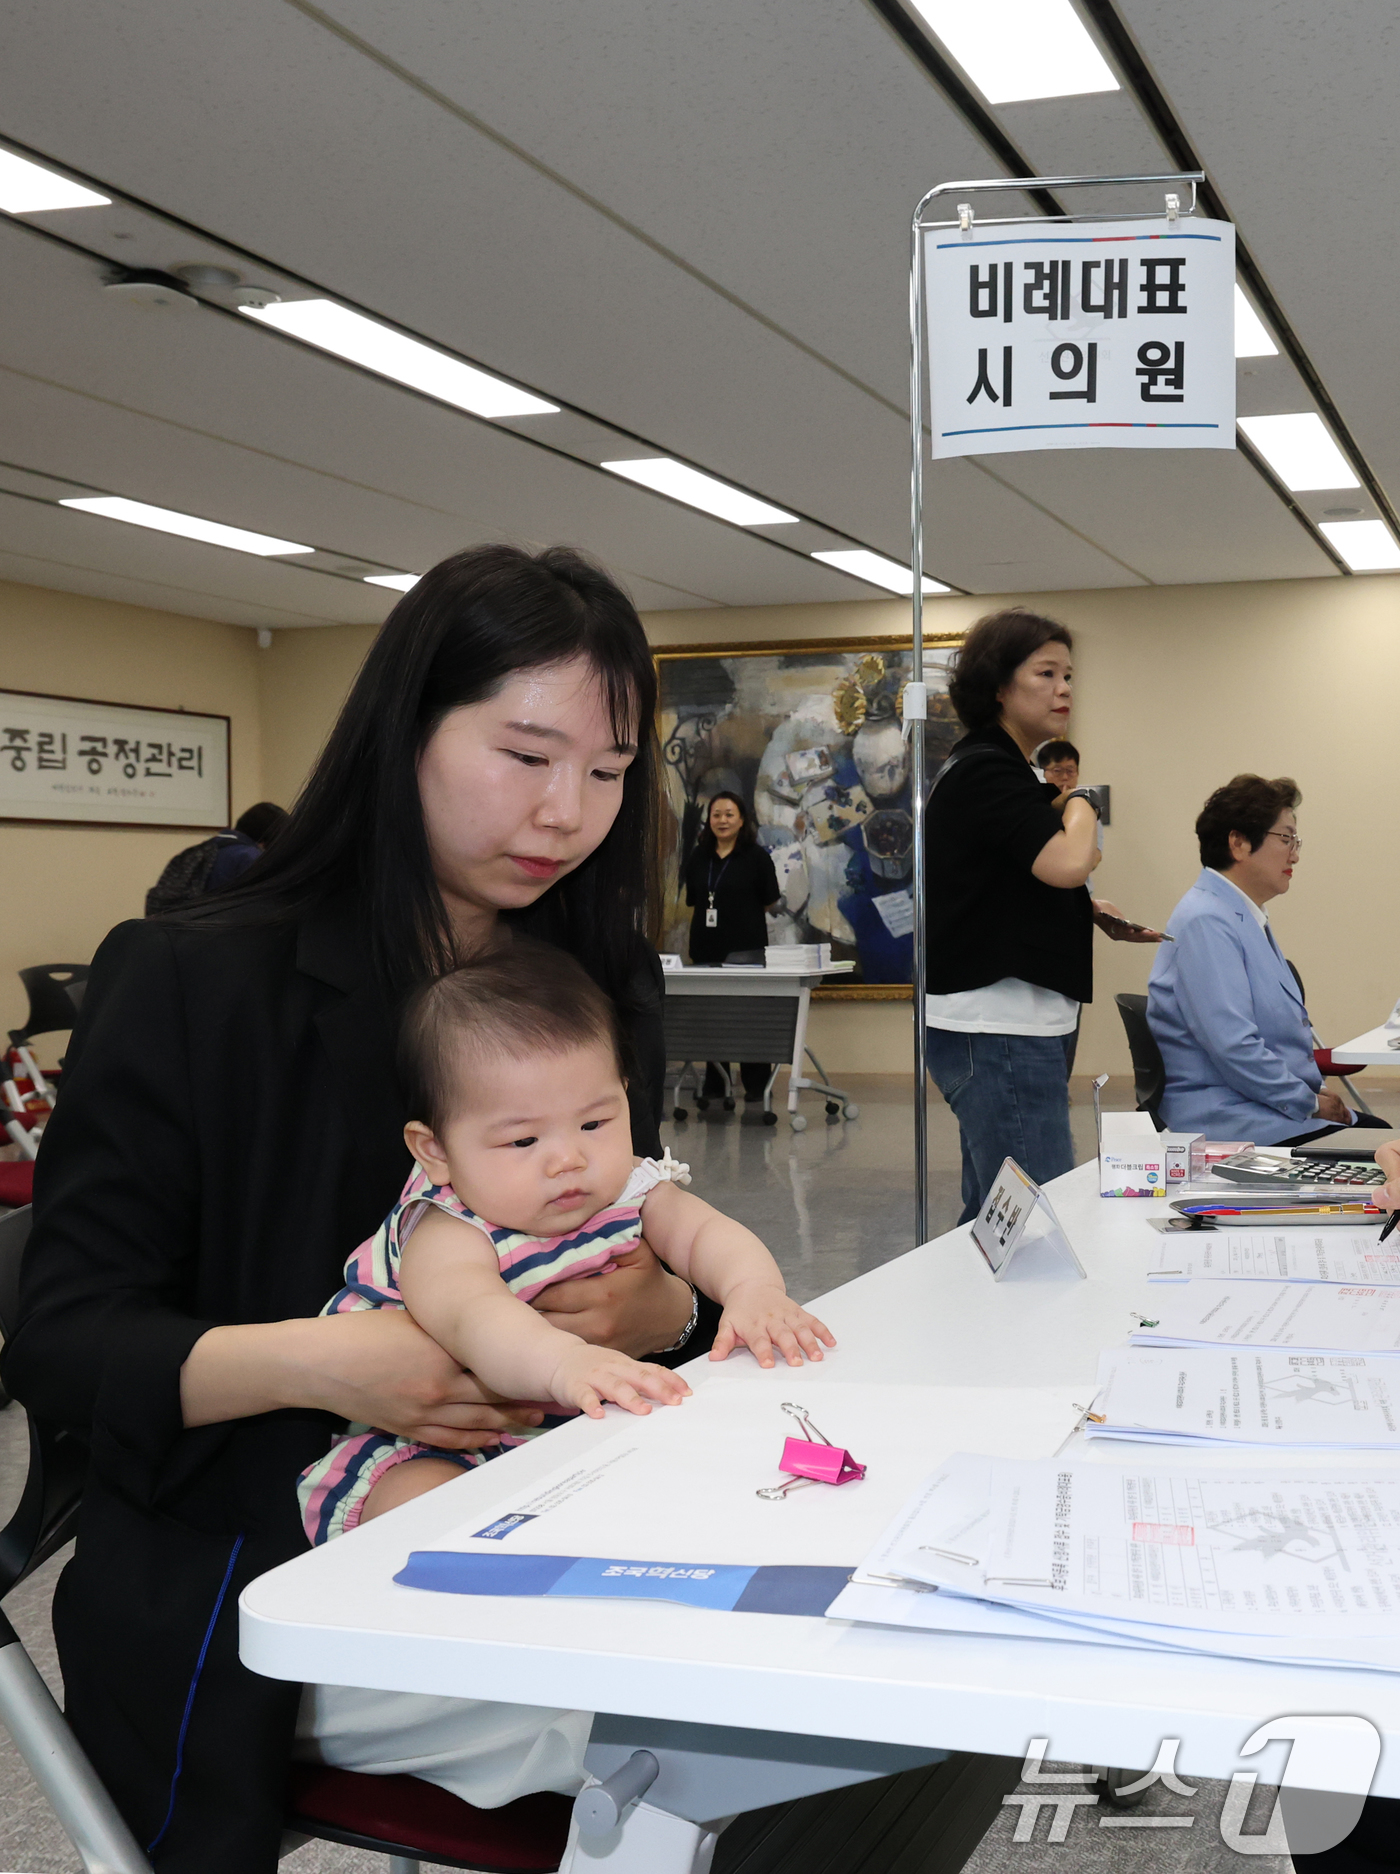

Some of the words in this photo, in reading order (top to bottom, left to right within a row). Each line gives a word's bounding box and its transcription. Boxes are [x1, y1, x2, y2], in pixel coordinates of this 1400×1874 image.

[969, 258, 1187, 323] 비례대표
[0, 727, 67, 772] 중립
[77, 735, 203, 778] 공정관리
[601, 1565, 716, 1580] 조국혁신당
